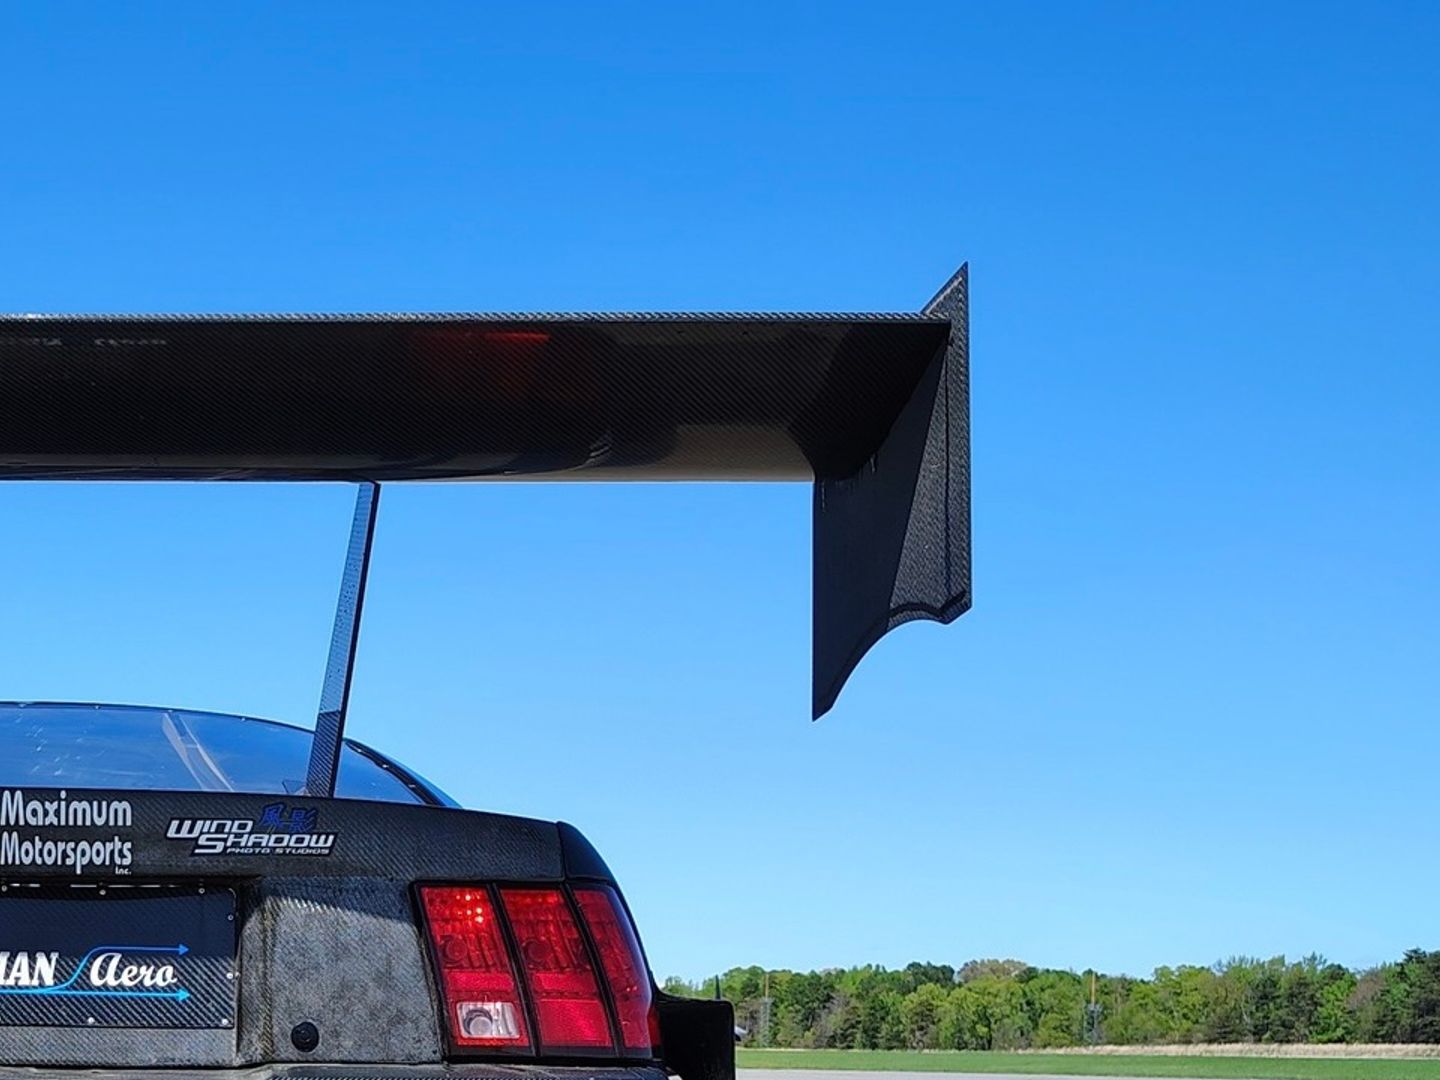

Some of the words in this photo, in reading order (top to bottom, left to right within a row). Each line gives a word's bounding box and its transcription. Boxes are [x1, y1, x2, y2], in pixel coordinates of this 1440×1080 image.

[0, 790, 132, 826] Maximum
[166, 820, 253, 838] WIND
[0, 831, 132, 875] Motorsports
[194, 834, 334, 854] SHADOW
[274, 847, 330, 855] STUDIOS
[115, 866, 132, 875] Inc.
[89, 952, 178, 987] Aero
